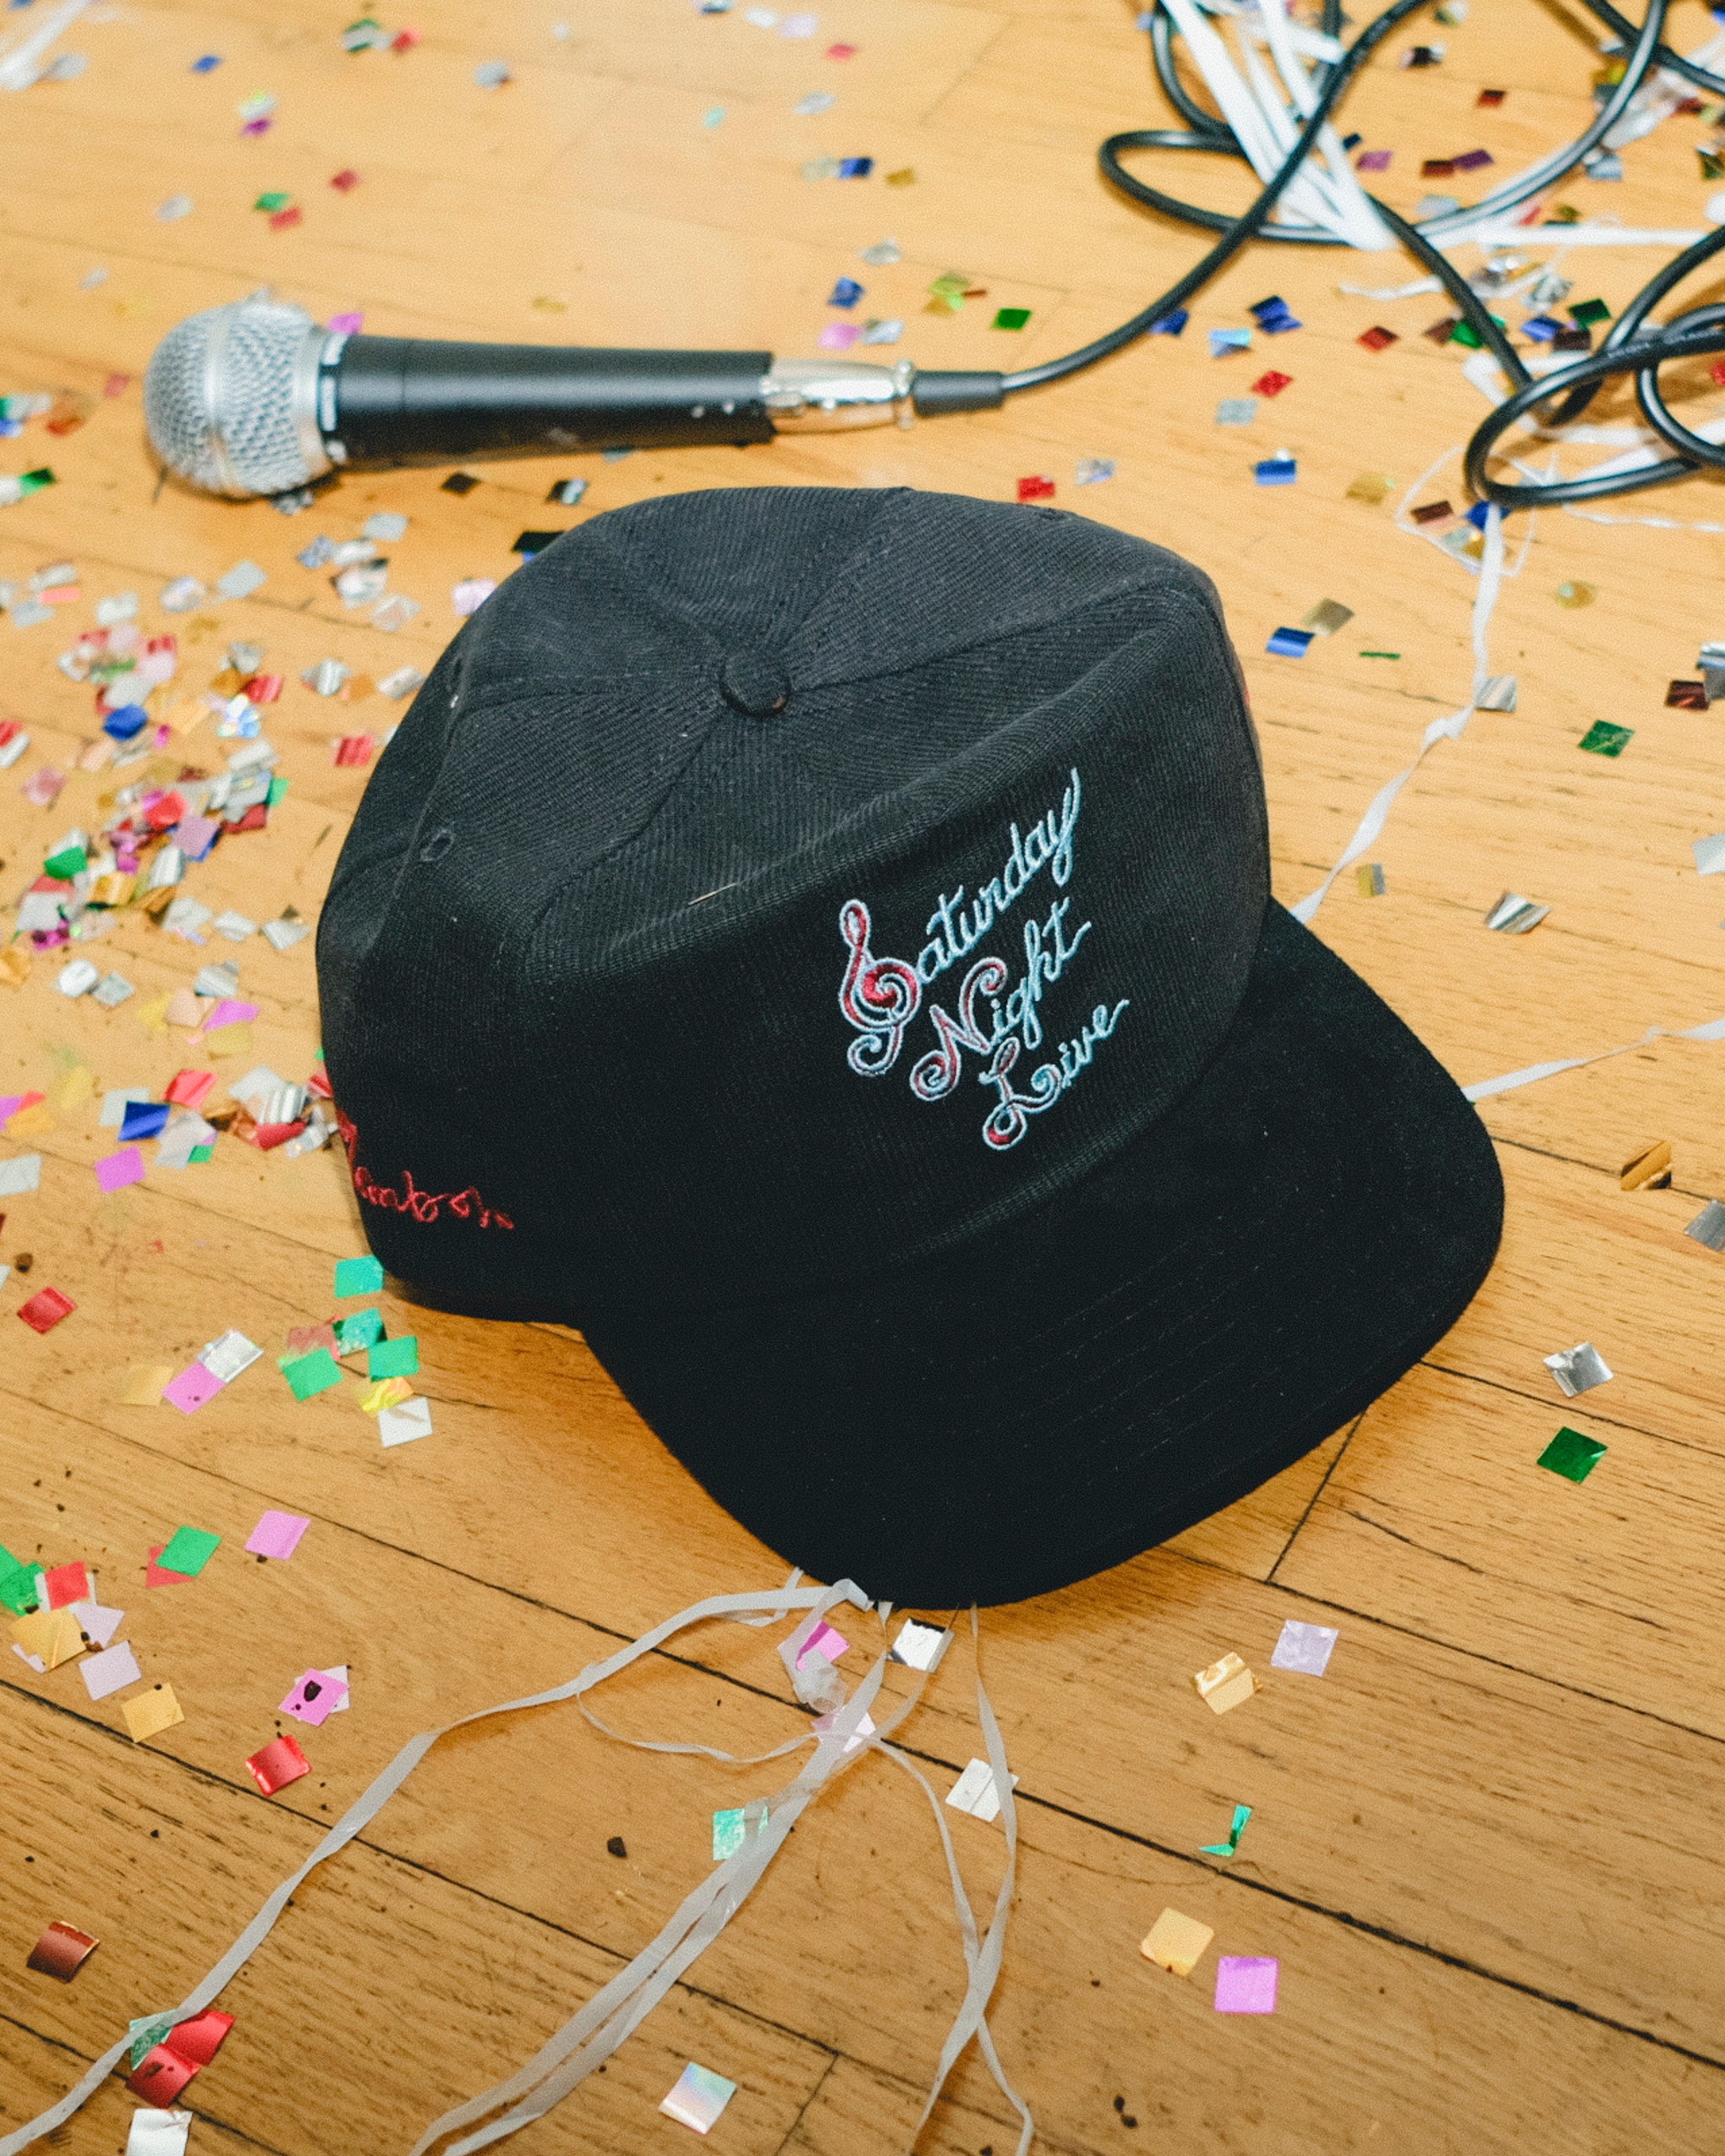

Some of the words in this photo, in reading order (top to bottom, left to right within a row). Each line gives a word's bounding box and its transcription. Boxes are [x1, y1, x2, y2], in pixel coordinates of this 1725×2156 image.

[839, 768, 1081, 1077] Saturday
[910, 897, 1092, 1101] Night
[978, 999, 1130, 1150] Live
